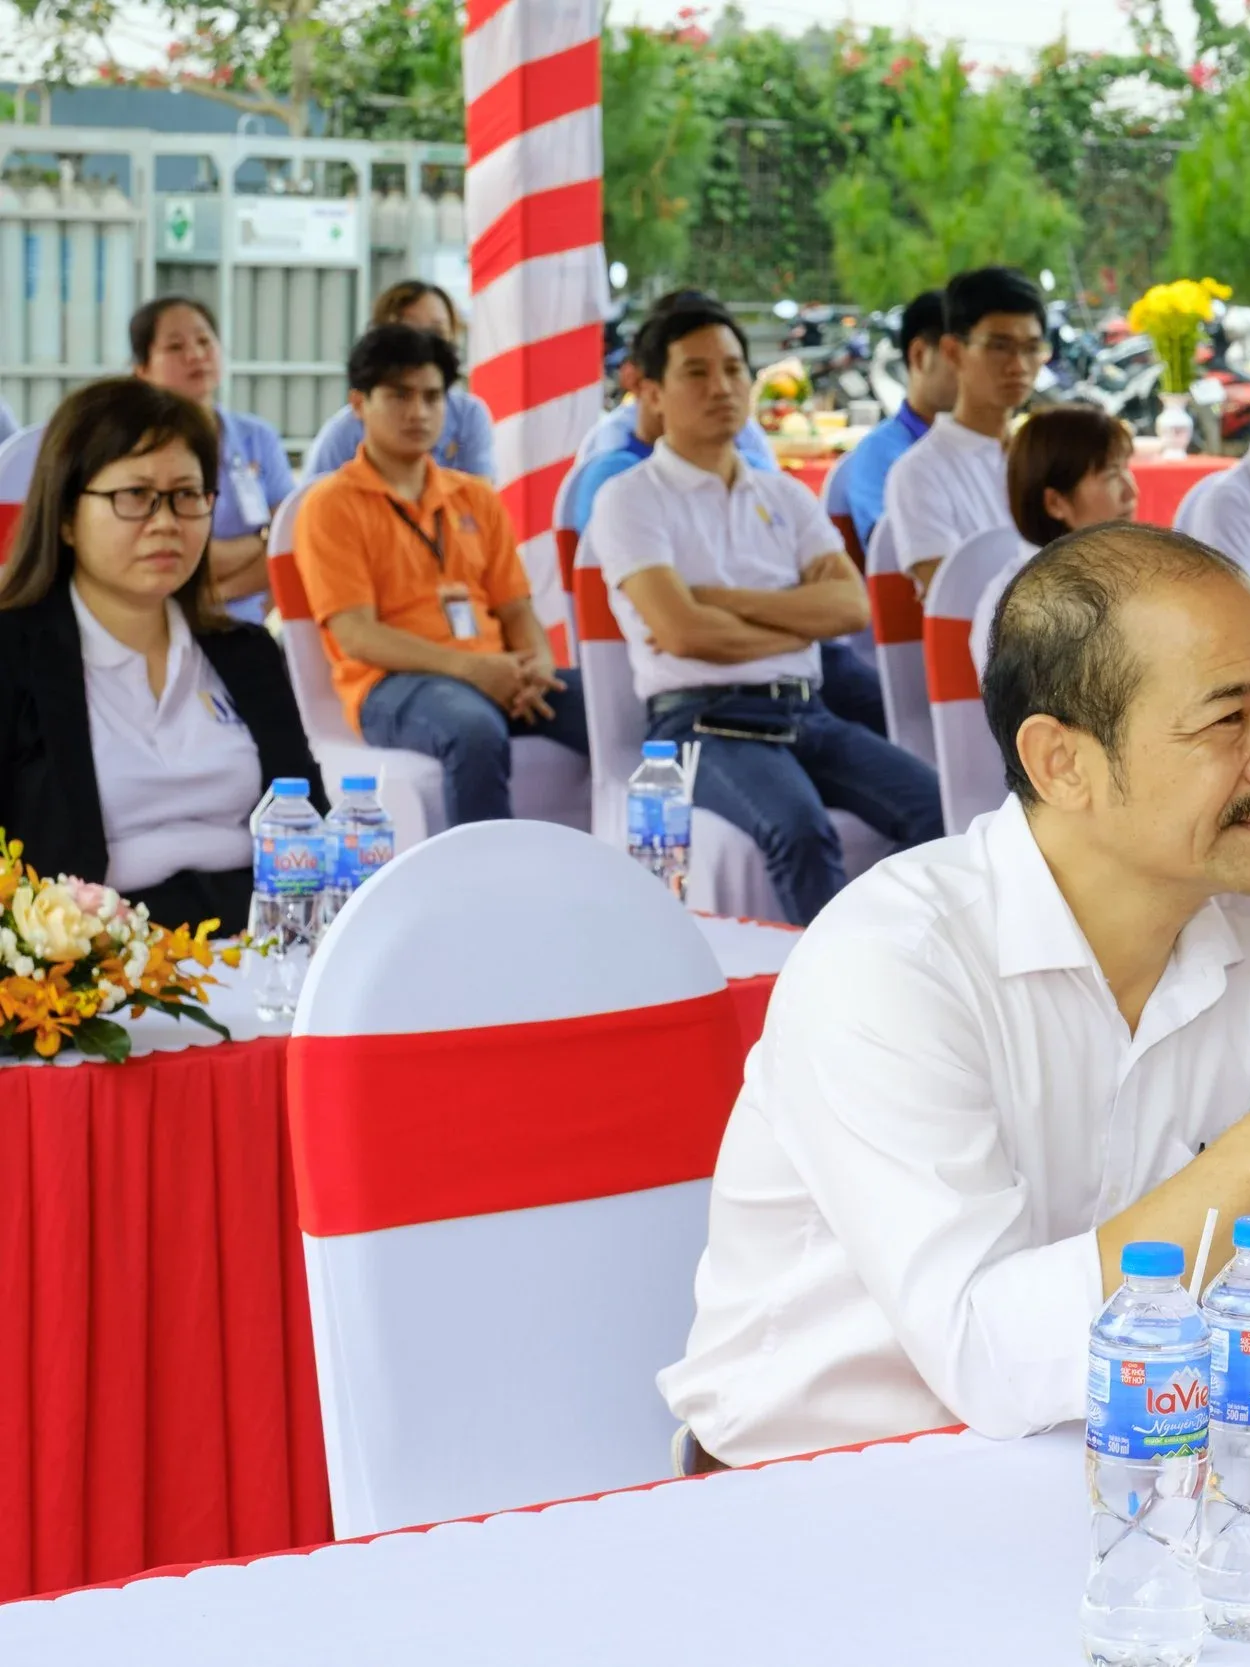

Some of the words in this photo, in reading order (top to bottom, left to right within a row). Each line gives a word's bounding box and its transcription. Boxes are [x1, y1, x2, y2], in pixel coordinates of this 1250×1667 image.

[1146, 1379, 1209, 1415] laVie
[1226, 1409, 1239, 1421] 500
[1107, 1440, 1120, 1454] 500
